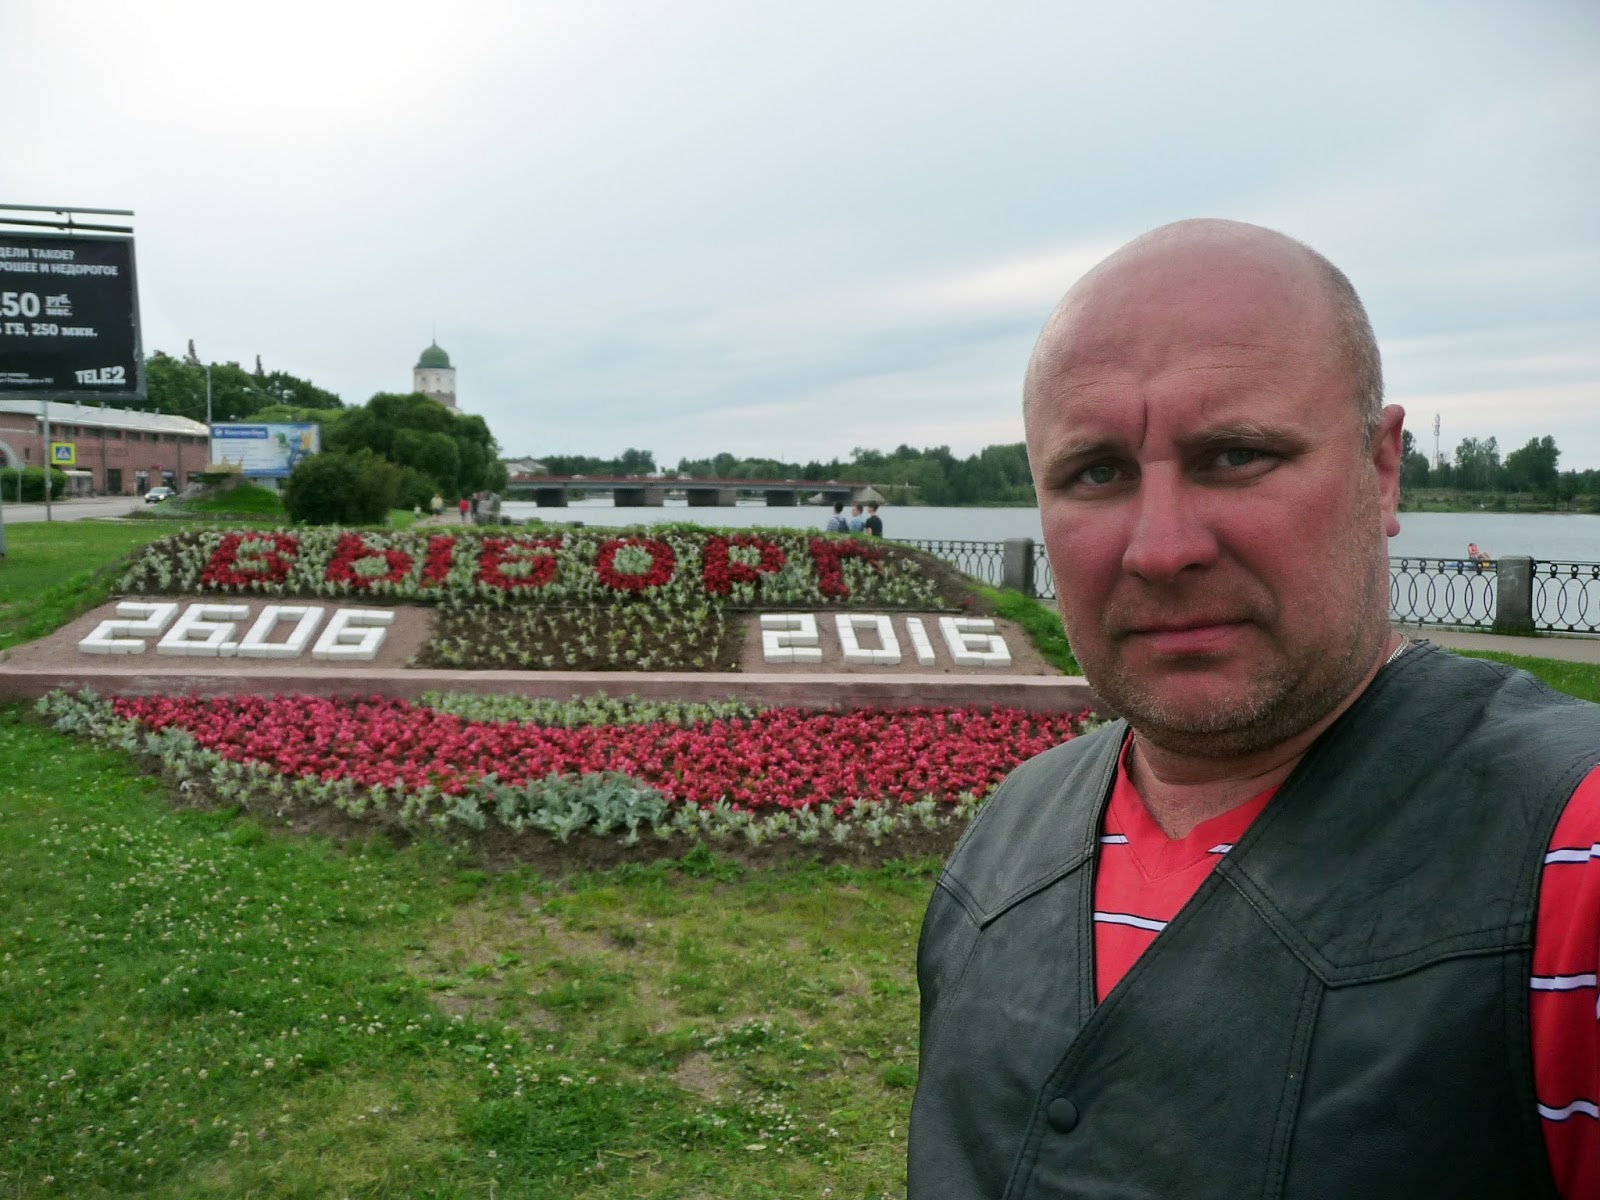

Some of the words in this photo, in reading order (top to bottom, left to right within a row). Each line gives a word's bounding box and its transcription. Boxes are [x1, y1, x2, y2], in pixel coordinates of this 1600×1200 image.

[31, 249, 75, 260] ТАКОЕ?
[40, 263, 49, 273] И
[51, 263, 118, 276] НЕДОРОГОЕ
[0, 292, 41, 317] 50
[31, 323, 58, 336] 250
[75, 366, 126, 384] TELE2
[760, 613, 1012, 667] 2016
